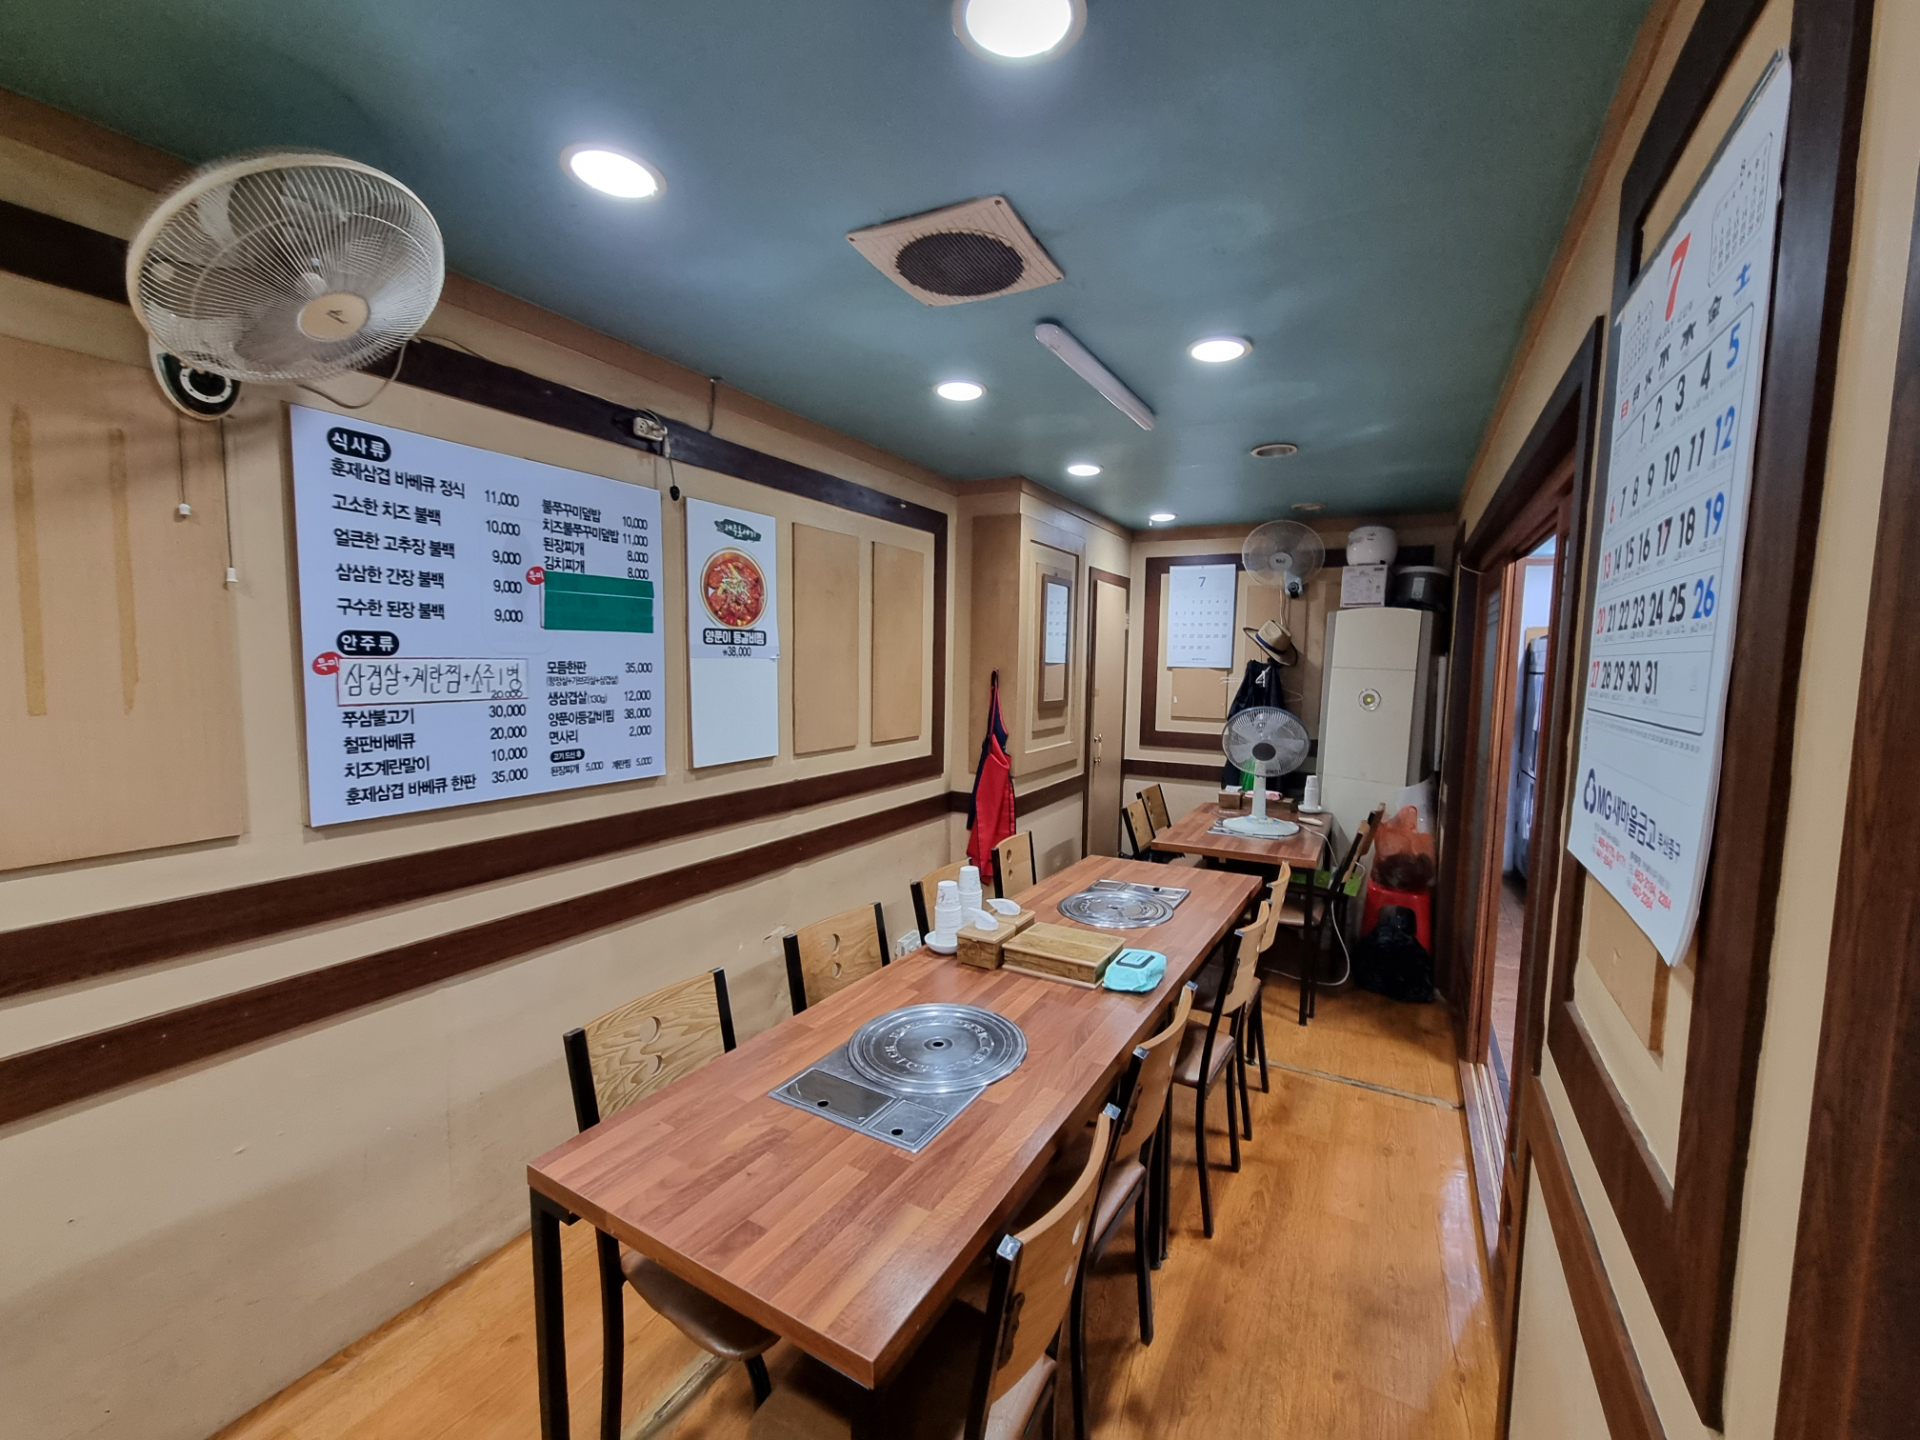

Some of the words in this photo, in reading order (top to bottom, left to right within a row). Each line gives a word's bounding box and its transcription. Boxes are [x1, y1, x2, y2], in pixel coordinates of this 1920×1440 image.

[1665, 233, 1690, 322] 7
[1733, 262, 1751, 297] 土
[1640, 412, 1646, 444] 1
[1654, 395, 1662, 430] 2
[1675, 374, 1685, 412] 3
[1700, 350, 1712, 390] 4
[1727, 322, 1741, 370] 5
[332, 432, 386, 458] 식사류
[1620, 486, 1627, 518] 7
[1632, 476, 1639, 507] 8
[1648, 463, 1655, 497] 9
[1664, 445, 1680, 486] 10
[1688, 427, 1705, 472] 11
[1714, 406, 1735, 456] 12
[330, 457, 390, 486] 훈제삼겹
[395, 471, 436, 494] 바베큐
[440, 479, 465, 499] 정식
[484, 490, 519, 508] 11,000
[332, 494, 378, 516] 고소한
[382, 501, 411, 520] 치즈
[414, 506, 441, 526] 불백
[486, 520, 520, 536] 10,000
[542, 499, 601, 523] 불쭈꾸미덮밥
[622, 516, 648, 530] 10,000
[334, 528, 380, 550] 얼큰한
[383, 536, 426, 556] 고추장
[428, 540, 455, 559] 불백
[492, 550, 521, 566] 9,000
[542, 519, 619, 544] 치즈불쭈꾸미덮밥
[623, 533, 648, 547] 11,000
[1604, 552, 1611, 580] 13
[1614, 544, 1622, 575] 14
[1625, 536, 1635, 570] 15
[1638, 528, 1650, 564] 16
[1657, 516, 1673, 556] 17
[1679, 506, 1696, 548] 18
[1704, 492, 1724, 538] 19
[543, 537, 585, 556] 된장찌개
[627, 550, 648, 564] 8,000
[336, 563, 382, 584] 삼삼한
[386, 568, 415, 586] 간장
[418, 570, 444, 589] 불백
[493, 580, 522, 594] 9,000
[544, 556, 585, 574] 김치찌개
[627, 568, 649, 580] 8,000
[1198, 576, 1206, 588] 7
[336, 598, 382, 616] 구수한
[386, 600, 415, 619] 된장
[418, 602, 445, 620] 불백
[494, 608, 523, 622] 9,000
[1607, 604, 1616, 632] 21
[1618, 600, 1630, 630] 22
[1632, 595, 1645, 628] 23
[1648, 589, 1664, 626] 24
[1667, 582, 1688, 623] 25
[1692, 575, 1715, 619] 26
[340, 634, 394, 651] 안주류
[705, 630, 731, 643] 양푼이
[546, 660, 586, 675] 모듬한판
[625, 662, 652, 674] 35,000
[1591, 661, 1600, 688] 27
[1601, 661, 1611, 689] 28
[1613, 661, 1625, 691] 29
[1627, 660, 1640, 693] 30
[1645, 660, 1658, 695] 31
[624, 690, 651, 701] 12,000
[342, 708, 415, 728] 쭈삼불고기
[488, 704, 526, 718] 30,000
[624, 708, 651, 720] 38,000
[344, 732, 416, 754] 철판바베큐
[490, 726, 528, 740] 20,000
[549, 730, 578, 745] 면사리
[629, 725, 652, 737] 2,000
[344, 755, 430, 779] 치즈계란말이
[492, 747, 528, 761] 10,000
[551, 764, 579, 776] 된장찌개
[586, 761, 603, 771] 5,000
[636, 757, 652, 767] 5,000
[346, 782, 404, 805] 훈제삼겹
[408, 777, 448, 796] 바베큐
[451, 774, 476, 792] 한판
[492, 768, 528, 784] 35,000
[1597, 785, 1656, 851] MG새마을금고
